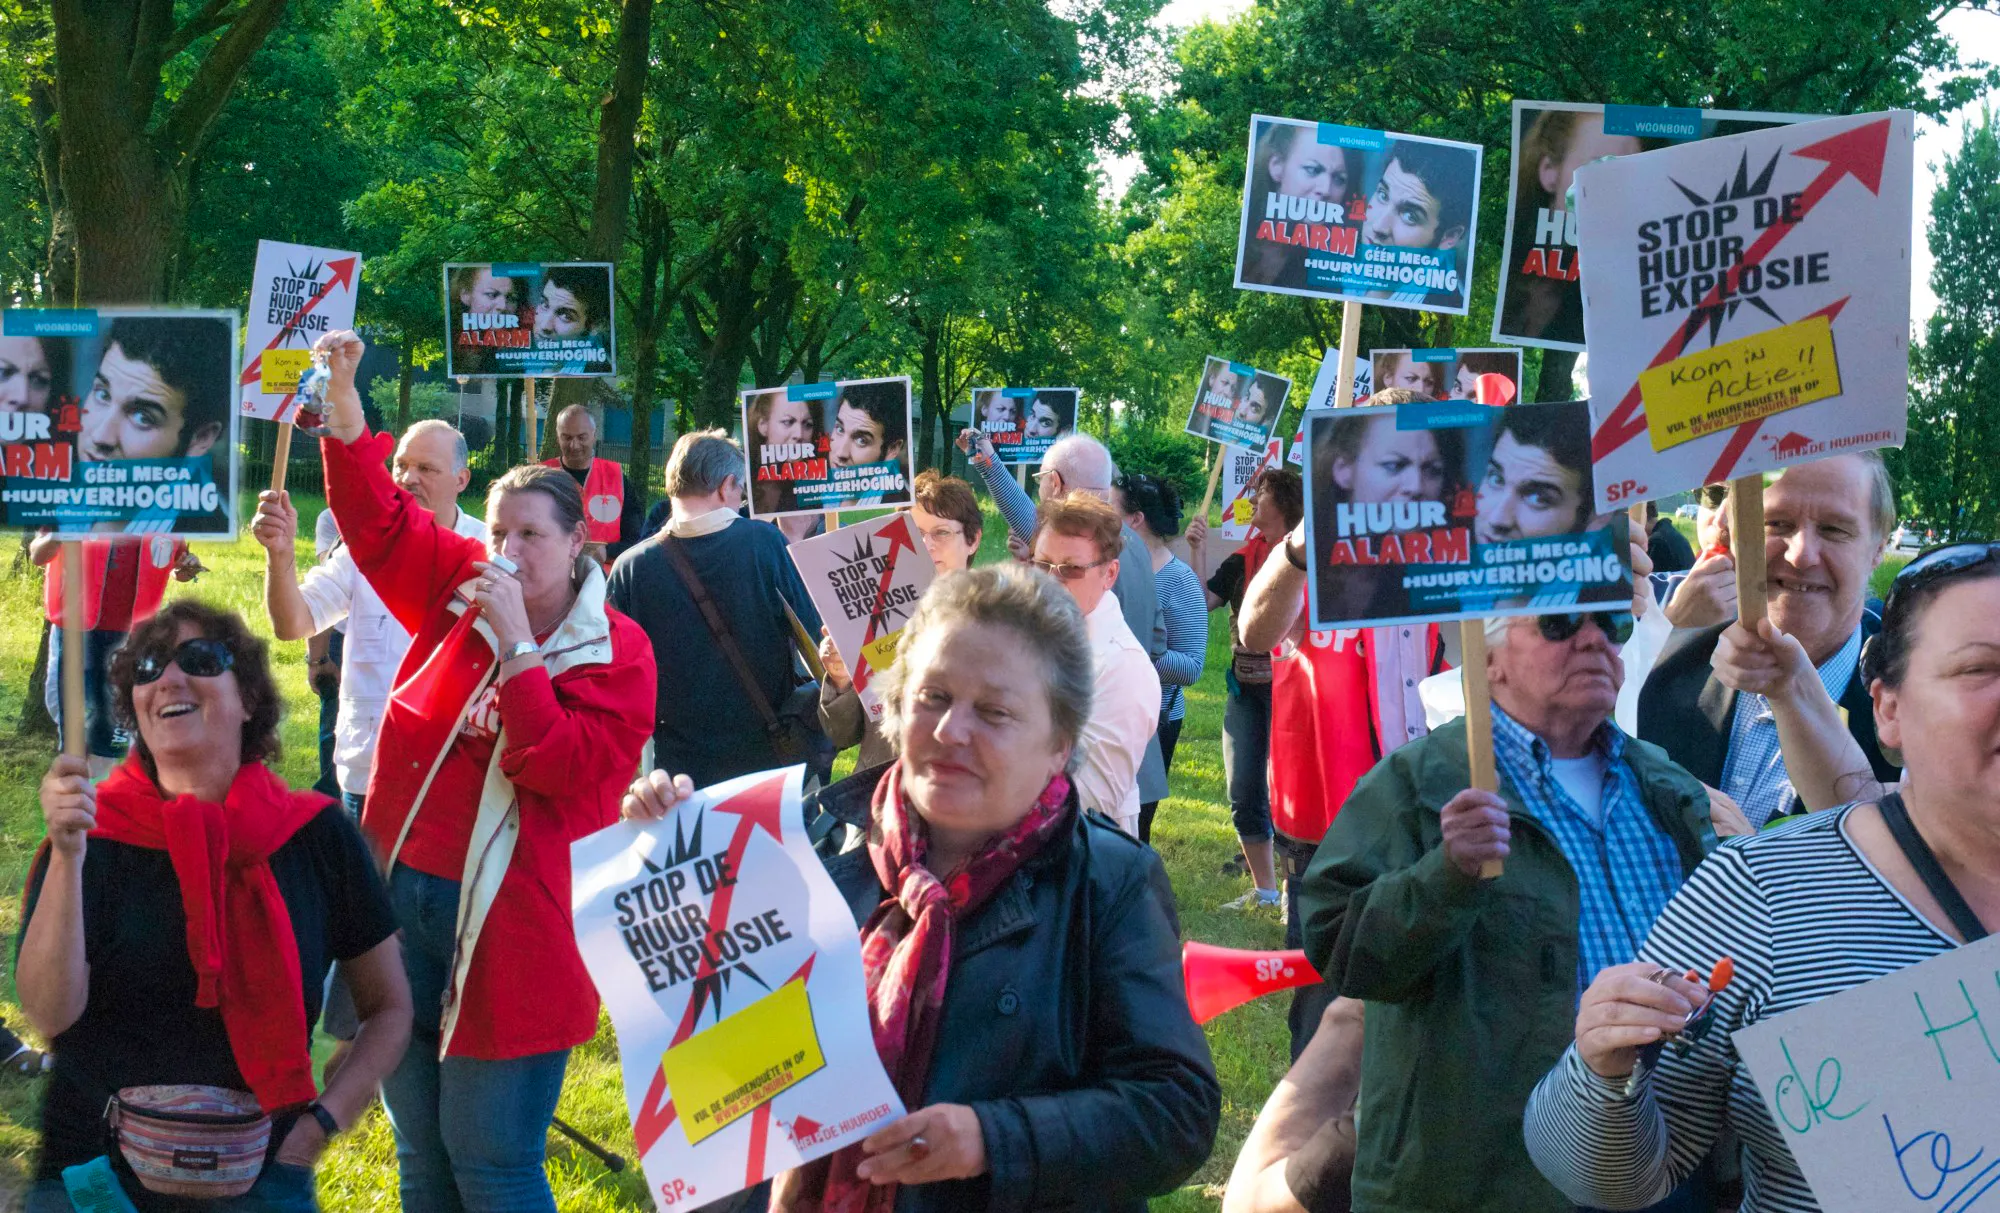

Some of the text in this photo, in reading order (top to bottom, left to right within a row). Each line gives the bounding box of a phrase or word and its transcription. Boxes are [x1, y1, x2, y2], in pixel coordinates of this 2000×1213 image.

[1635, 122, 1695, 135] WOONBOND
[1339, 137, 1381, 148] WOONBOND
[1266, 192, 1344, 224] HUUR
[1638, 191, 1804, 254] STOP DE
[1256, 220, 1358, 258] ALARM
[1364, 247, 1440, 267] GÉÉN MEGA
[1639, 235, 1744, 288] HUUR
[1304, 258, 1458, 292] HUURVERHOGING
[1640, 252, 1830, 319] EXPLOSIE
[272, 276, 326, 299] STOP DE
[269, 294, 304, 311] HUUR
[34, 323, 93, 332] WOONBOND
[267, 308, 329, 332] EXPLOSIE
[462, 312, 519, 331] HUUR
[459, 328, 531, 349] ALARM
[562, 340, 592, 349] MEGA
[495, 348, 607, 363] HUURVERHOGING
[1203, 390, 1233, 409] HUUR
[1666, 419, 1688, 435] VUL
[1689, 413, 1705, 428] DE
[1789, 384, 1802, 396] IN
[1805, 379, 1820, 393] OP
[0, 412, 51, 441] UR
[981, 421, 1016, 433] HUUR
[760, 443, 815, 465] HUUR
[1808, 440, 1826, 455] DE
[1830, 430, 1891, 449] HUURDER
[757, 457, 828, 481] ALARM
[858, 466, 889, 476] MEGA
[1235, 456, 1254, 466] STOP
[1235, 466, 1256, 476] HUUR
[84, 463, 191, 484] GÉÉN MEGA
[793, 473, 905, 495] HUURVERHOGING
[2, 483, 219, 512] HUURVERHOGING
[1337, 501, 1447, 537] HUUR
[1329, 527, 1471, 566] ALARM
[1483, 542, 1591, 565] GÉÉN MEGA
[827, 554, 895, 588] STOP DE
[1403, 554, 1622, 589] HUURVERHOGING
[834, 577, 881, 605] HUUR
[843, 584, 920, 621] EXPLOSIE
[613, 850, 738, 927] STOP DE
[621, 903, 712, 960] HUUR
[639, 909, 792, 993] EXPLOSIE
[693, 1108, 710, 1124] VUL
[710, 1100, 722, 1114] DE
[782, 1058, 793, 1070] IN
[794, 1050, 805, 1064] OP
[823, 1125, 839, 1141] DE
[839, 1103, 891, 1134] HUURDER
